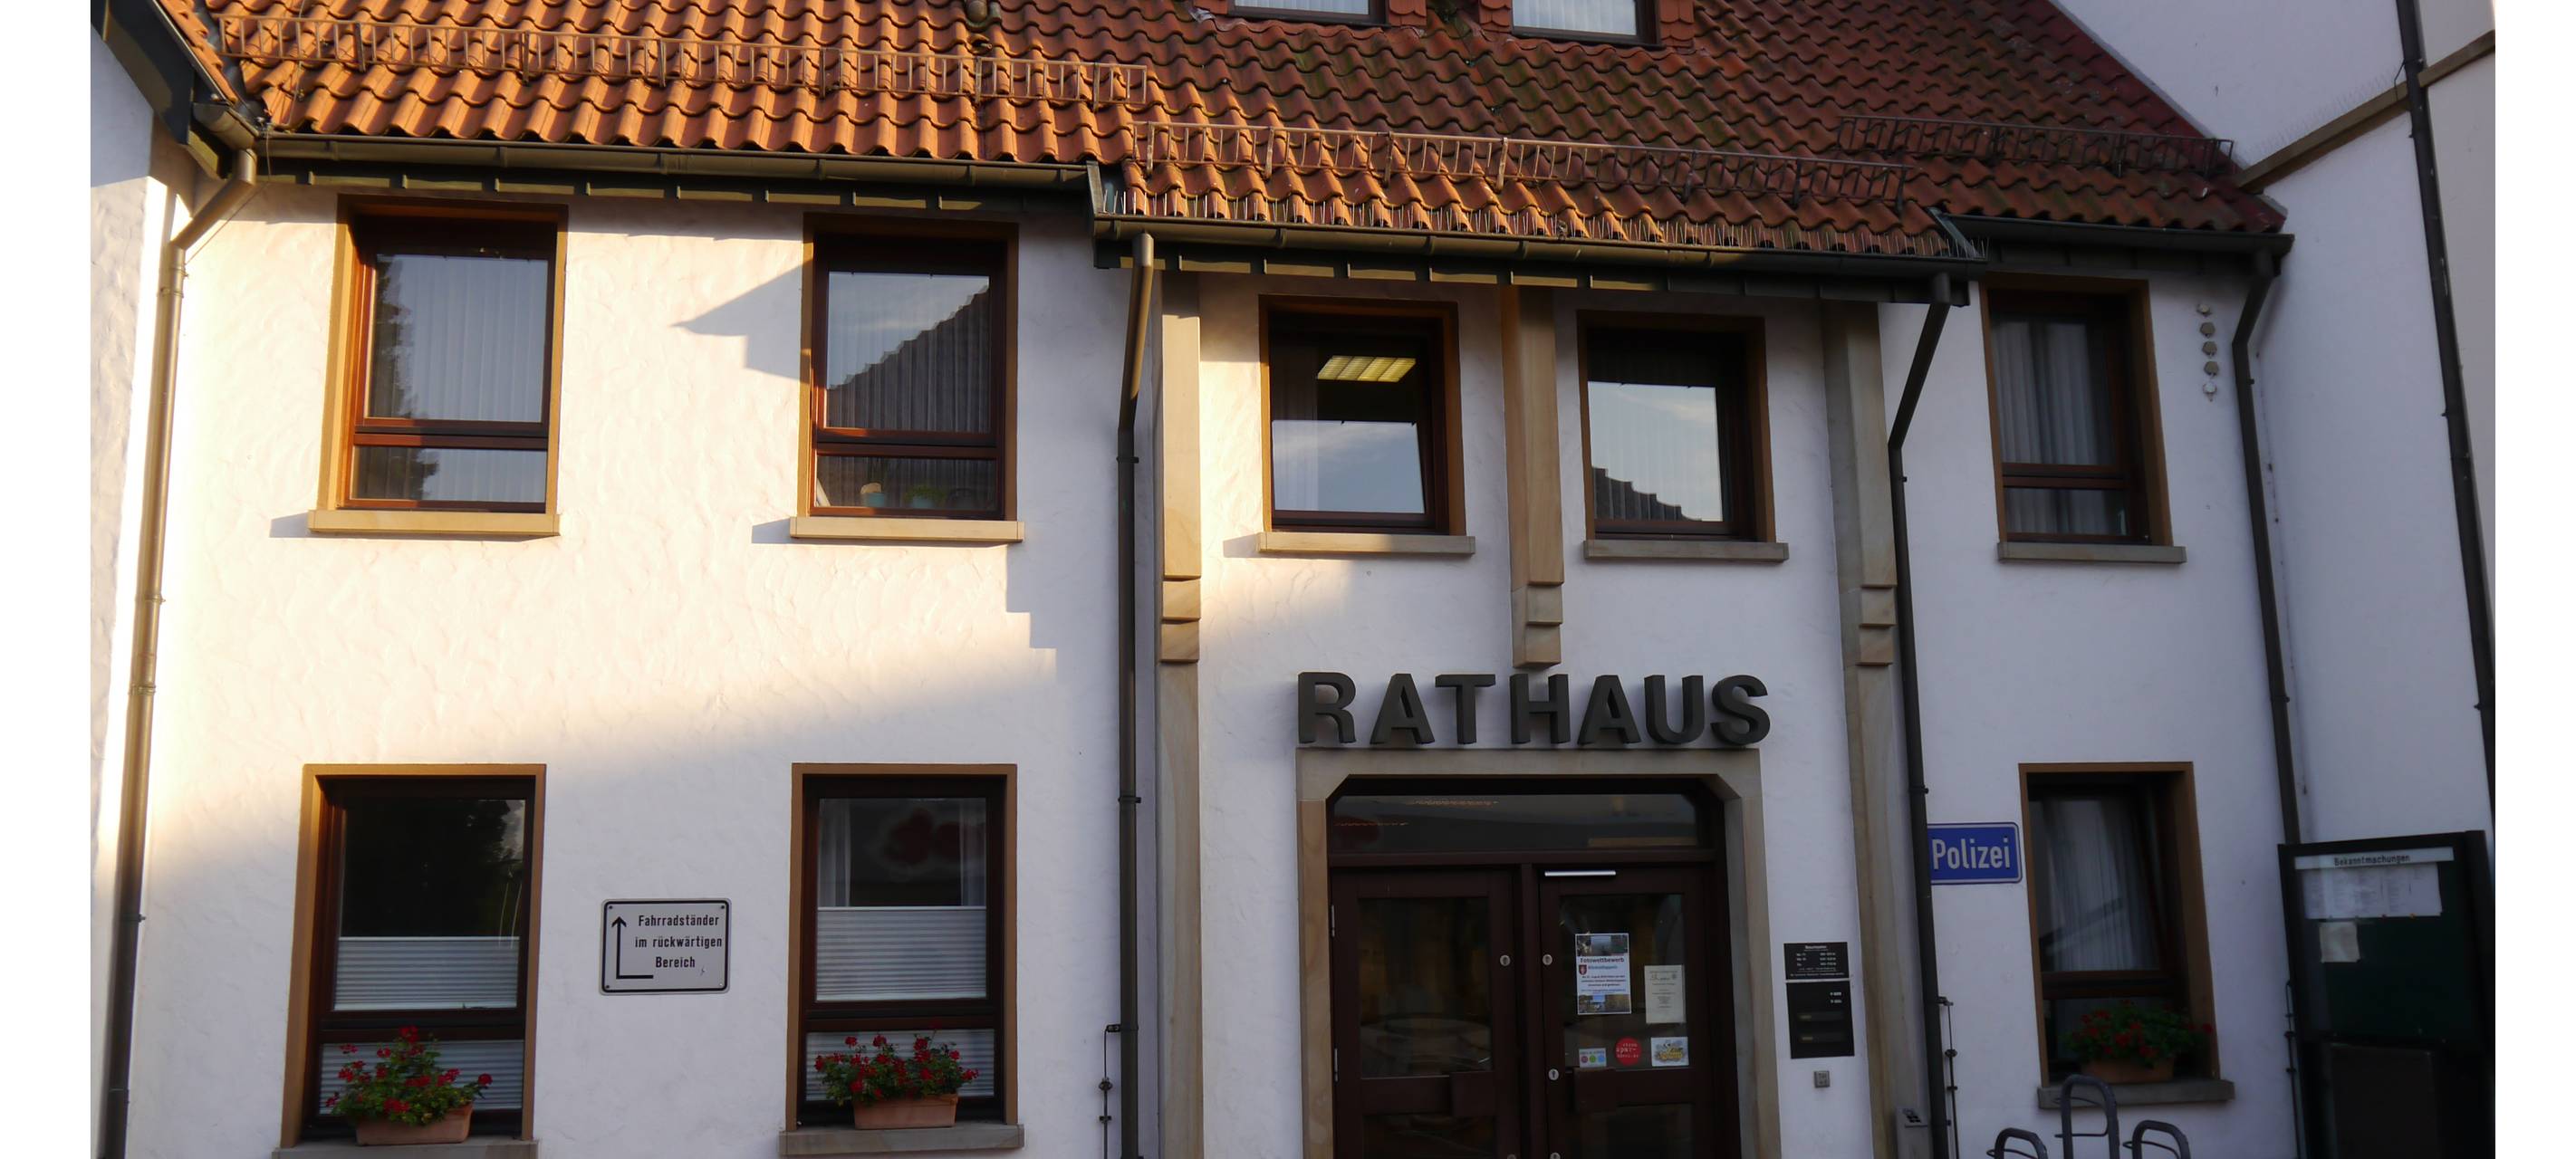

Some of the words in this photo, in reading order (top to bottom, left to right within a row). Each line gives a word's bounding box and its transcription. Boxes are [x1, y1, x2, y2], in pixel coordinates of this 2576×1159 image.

[1297, 671, 1771, 745] RATHAUS
[1931, 838, 2011, 870] Polizei
[2333, 854, 2410, 867] Bekanntmachungen
[638, 914, 720, 927] Fahrradständer
[635, 936, 647, 948] im
[652, 936, 723, 949] rückwärtigen
[655, 956, 696, 968] Bereich
